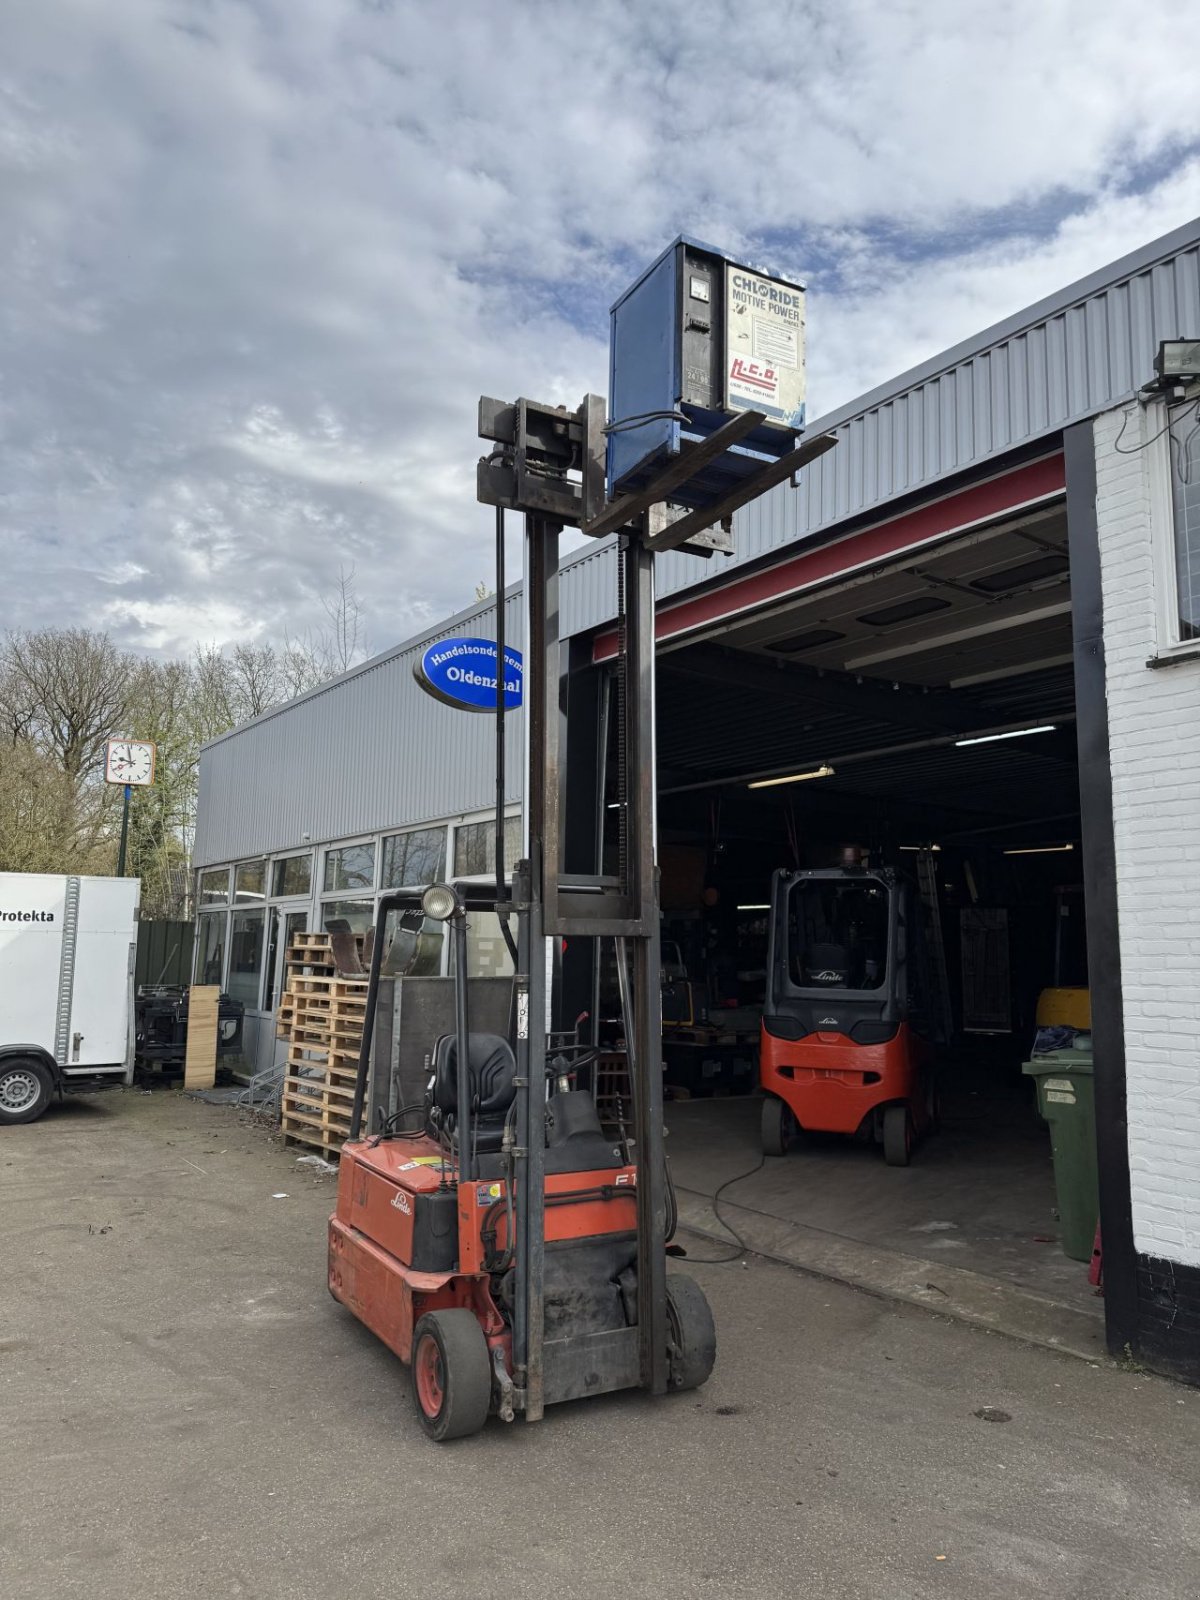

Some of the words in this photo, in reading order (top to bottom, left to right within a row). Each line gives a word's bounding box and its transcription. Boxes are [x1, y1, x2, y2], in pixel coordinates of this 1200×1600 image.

[732, 289, 766, 310] MOTIVE
[768, 302, 800, 321] POWER
[733, 275, 800, 308] CHLORIDE
[430, 644, 523, 674] Handelsondenem
[811, 970, 844, 981] Linde
[818, 1017, 839, 1025] Linde
[390, 1192, 413, 1216] Linde
